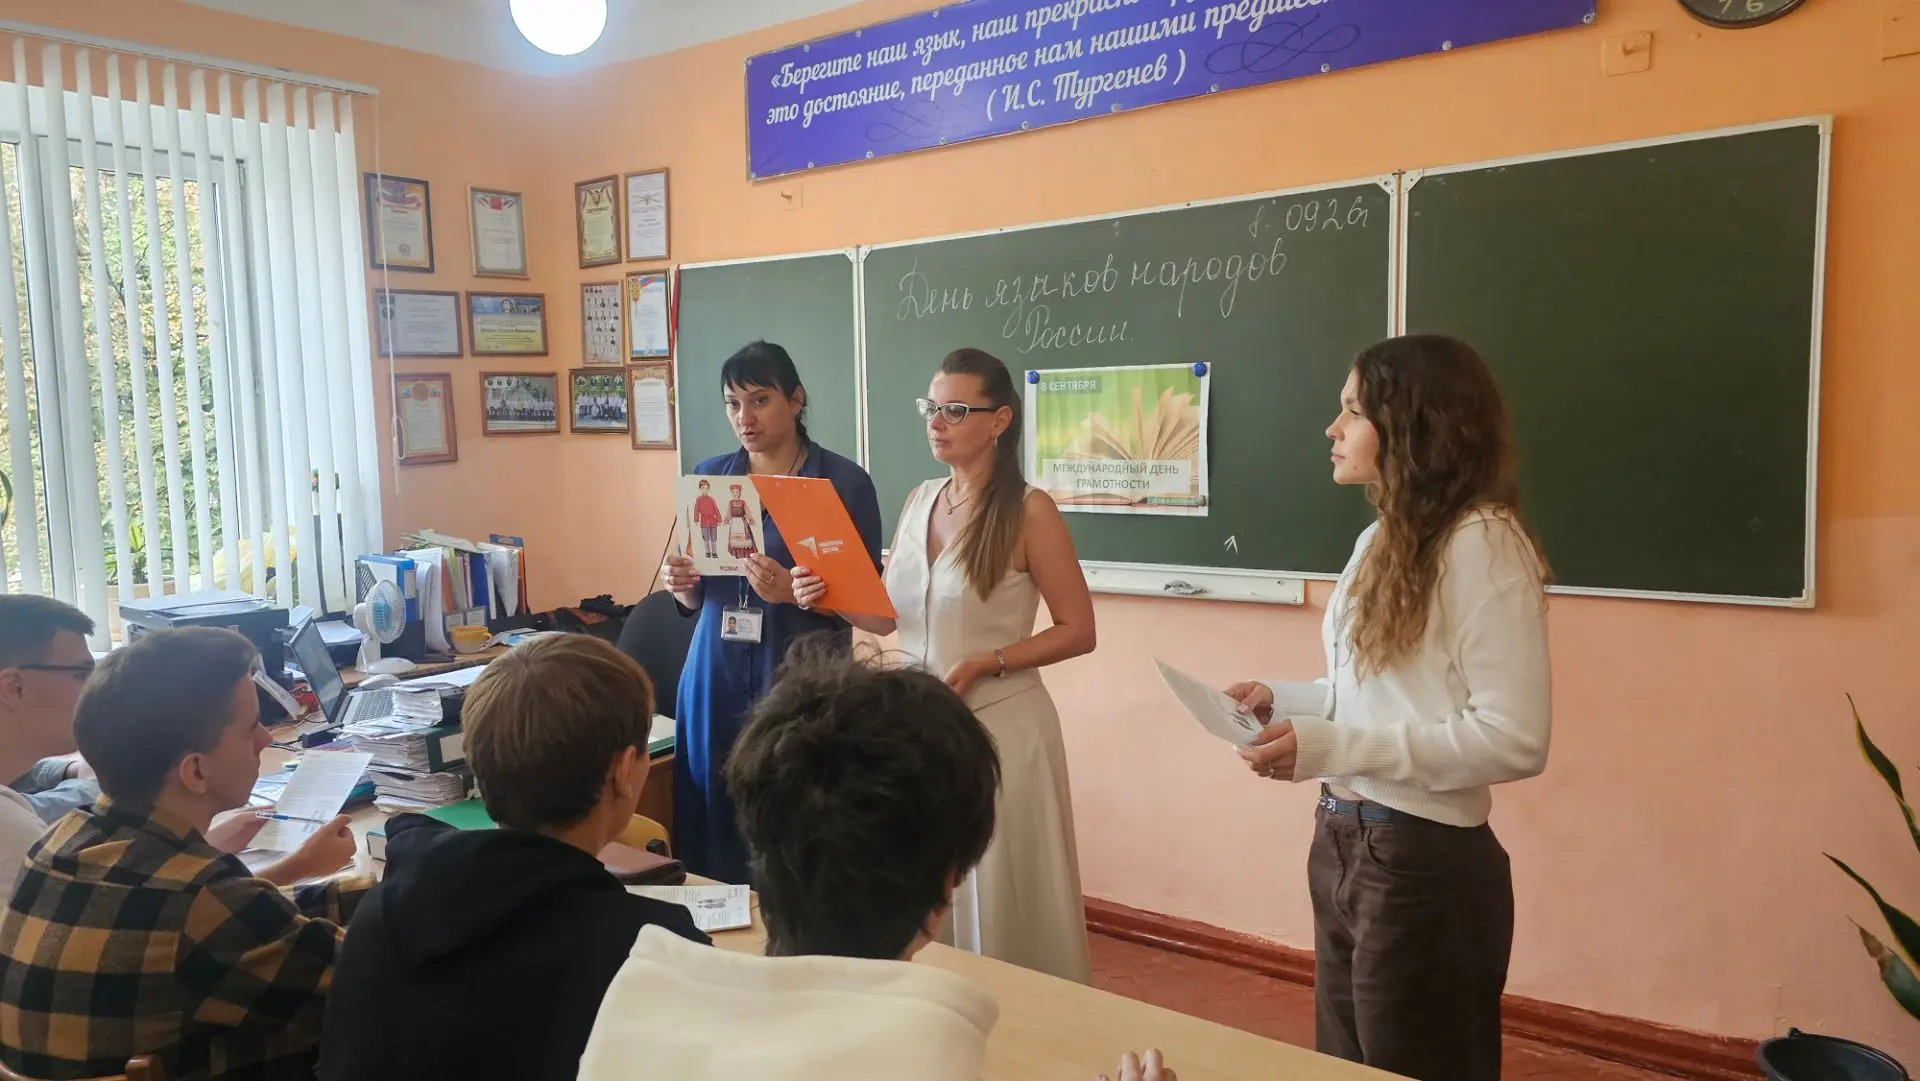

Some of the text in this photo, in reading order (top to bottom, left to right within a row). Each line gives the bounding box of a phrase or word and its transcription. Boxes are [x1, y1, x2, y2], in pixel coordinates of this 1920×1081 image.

[766, 103, 799, 125] это
[802, 80, 906, 128] достояние,
[910, 51, 1029, 101] переданное
[1033, 38, 1084, 68] нам
[1089, 12, 1197, 55] нашими
[771, 53, 862, 94] «Берегите
[866, 42, 908, 68] наш
[912, 29, 966, 65] язык,
[971, 14, 1019, 42] наш
[1052, 53, 1168, 110] Тургенев
[897, 237, 1288, 339] День языков народов
[1040, 379, 1097, 392] 8 СЕНТЯБРЯ
[1053, 462, 1179, 475] МЕЖДУНАРОДНЫЙ ДЕНЬ
[1076, 479, 1150, 490] ГРАМОТНОСТИ
